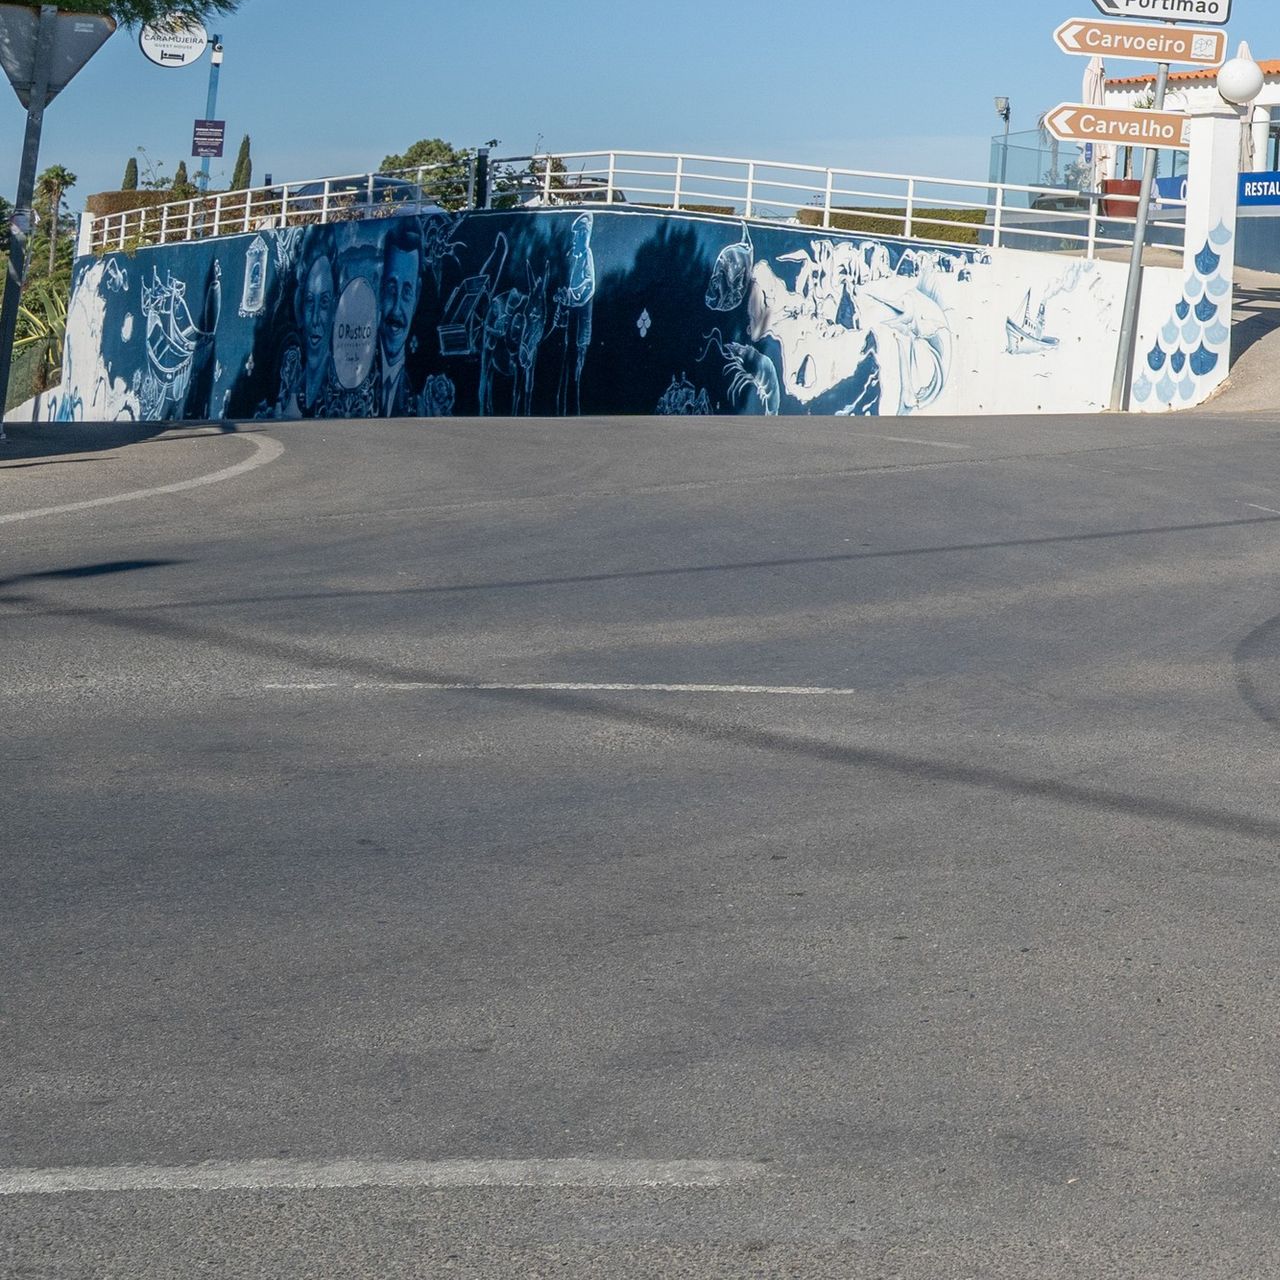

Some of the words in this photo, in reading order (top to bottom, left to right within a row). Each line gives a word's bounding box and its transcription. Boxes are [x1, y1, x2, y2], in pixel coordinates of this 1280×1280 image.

[144, 34, 204, 44] CARAMUJEIRA
[1086, 29, 1185, 53] Carvoeiro
[1080, 115, 1174, 139] Carvalho
